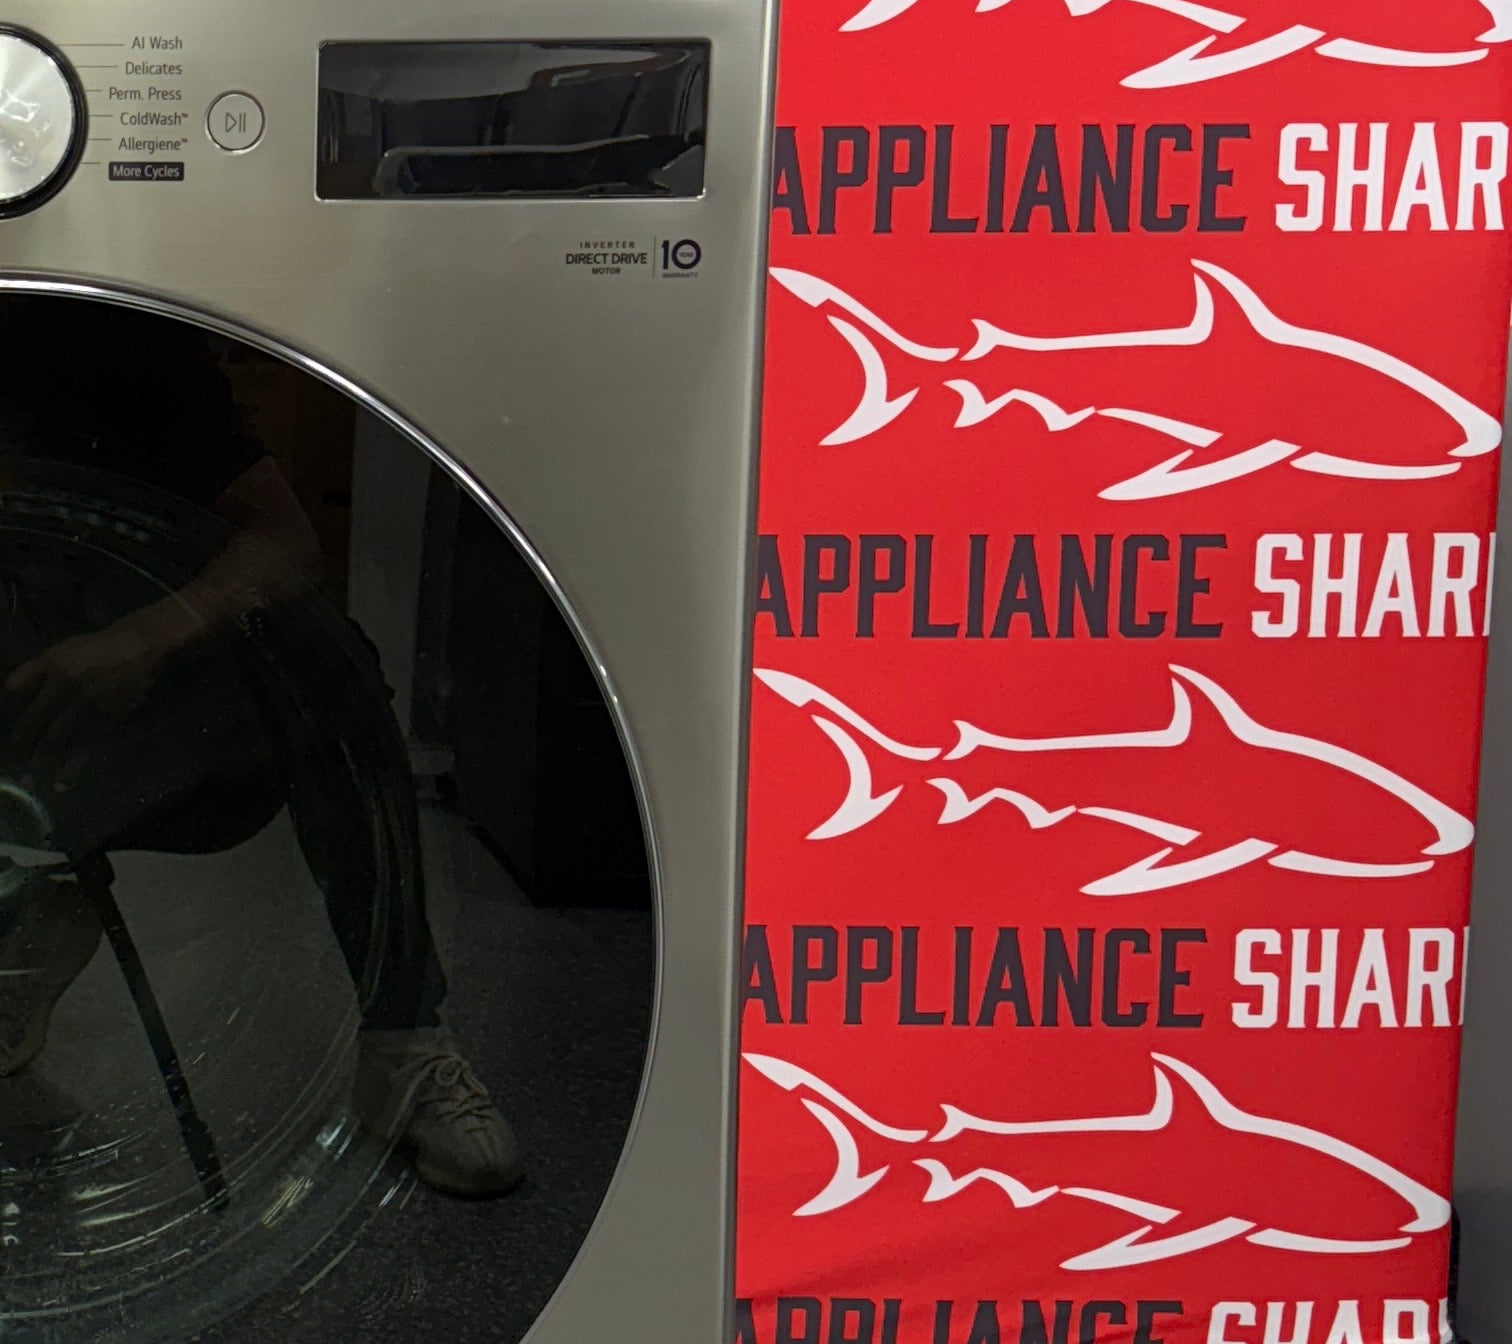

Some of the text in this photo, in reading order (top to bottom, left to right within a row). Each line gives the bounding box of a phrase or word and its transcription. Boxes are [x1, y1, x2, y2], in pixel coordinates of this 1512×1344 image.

[131, 36, 183, 50] AI Wash
[125, 61, 183, 75] Delicates
[109, 86, 182, 100] Perm. Press
[112, 164, 181, 180] More Cycles
[565, 252, 648, 265] DIRECT DRIVE
[591, 267, 621, 275] MOTOR
[1250, 532, 1496, 638] SHAR
[742, 924, 1470, 1029] APPLIANCE SHAR
